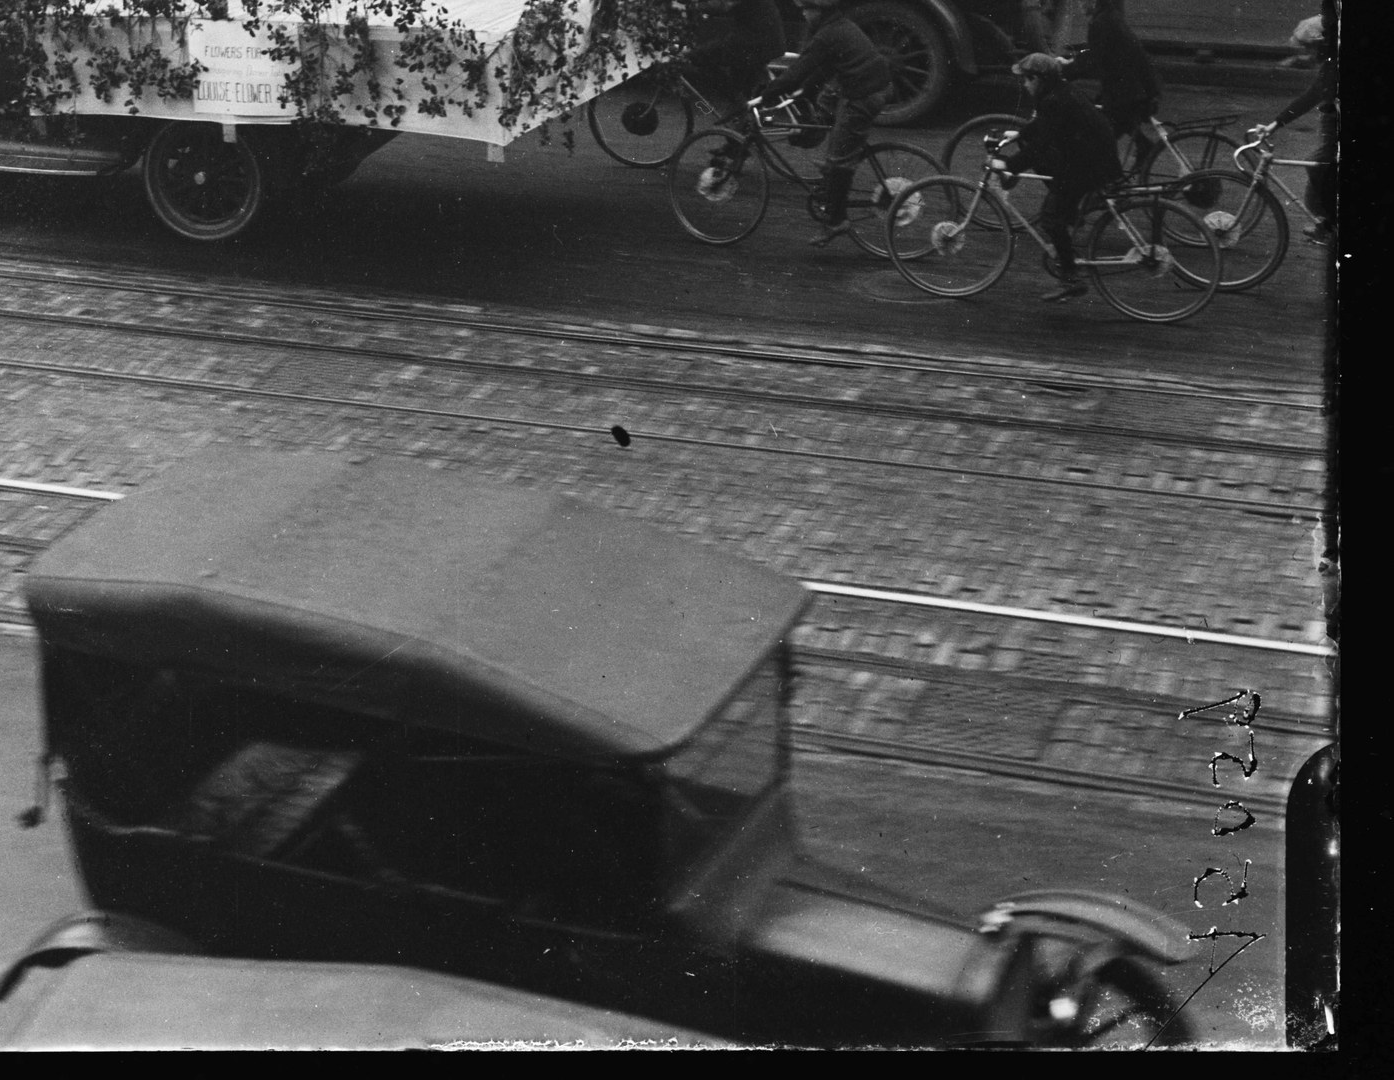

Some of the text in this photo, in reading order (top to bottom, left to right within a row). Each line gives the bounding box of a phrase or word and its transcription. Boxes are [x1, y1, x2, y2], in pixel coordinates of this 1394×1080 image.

[204, 45, 243, 59] FLOWERS
[246, 46, 262, 60] FOR
[197, 80, 232, 103] LOUISE
